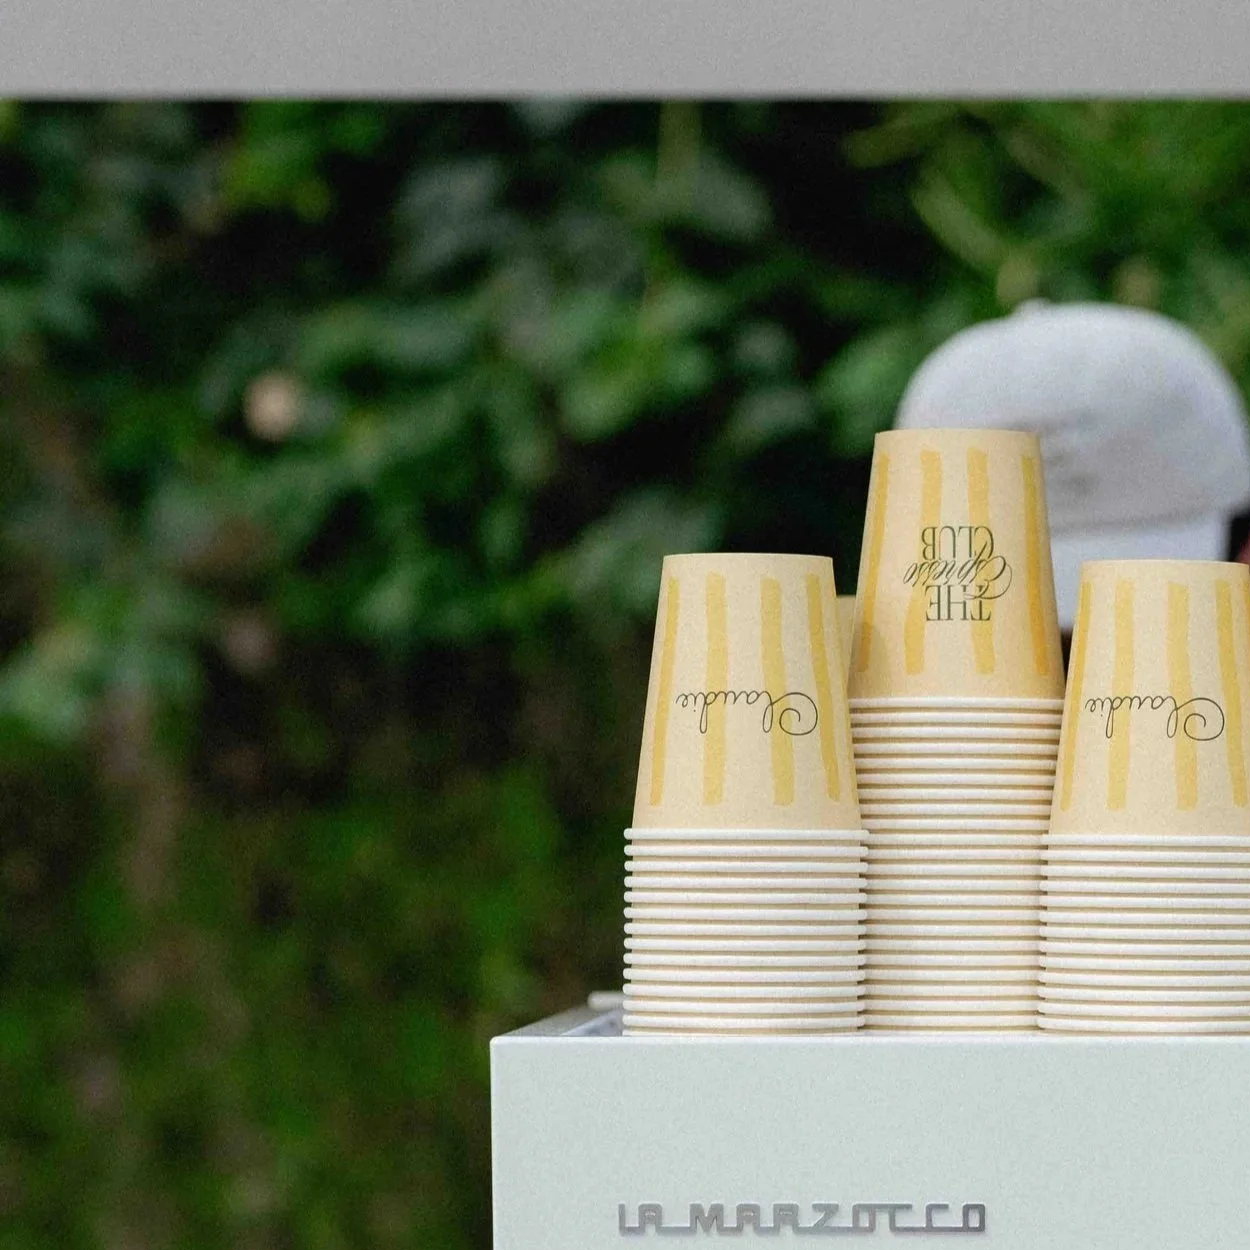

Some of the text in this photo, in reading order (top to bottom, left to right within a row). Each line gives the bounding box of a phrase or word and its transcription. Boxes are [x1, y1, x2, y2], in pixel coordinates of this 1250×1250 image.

[921, 526, 995, 561] CLUB
[903, 541, 1012, 600] Espresso
[925, 585, 991, 621] THE
[676, 691, 818, 736] Claudie
[1085, 695, 1225, 741] Claudie
[618, 1203, 986, 1236] LA MARZOCCO
